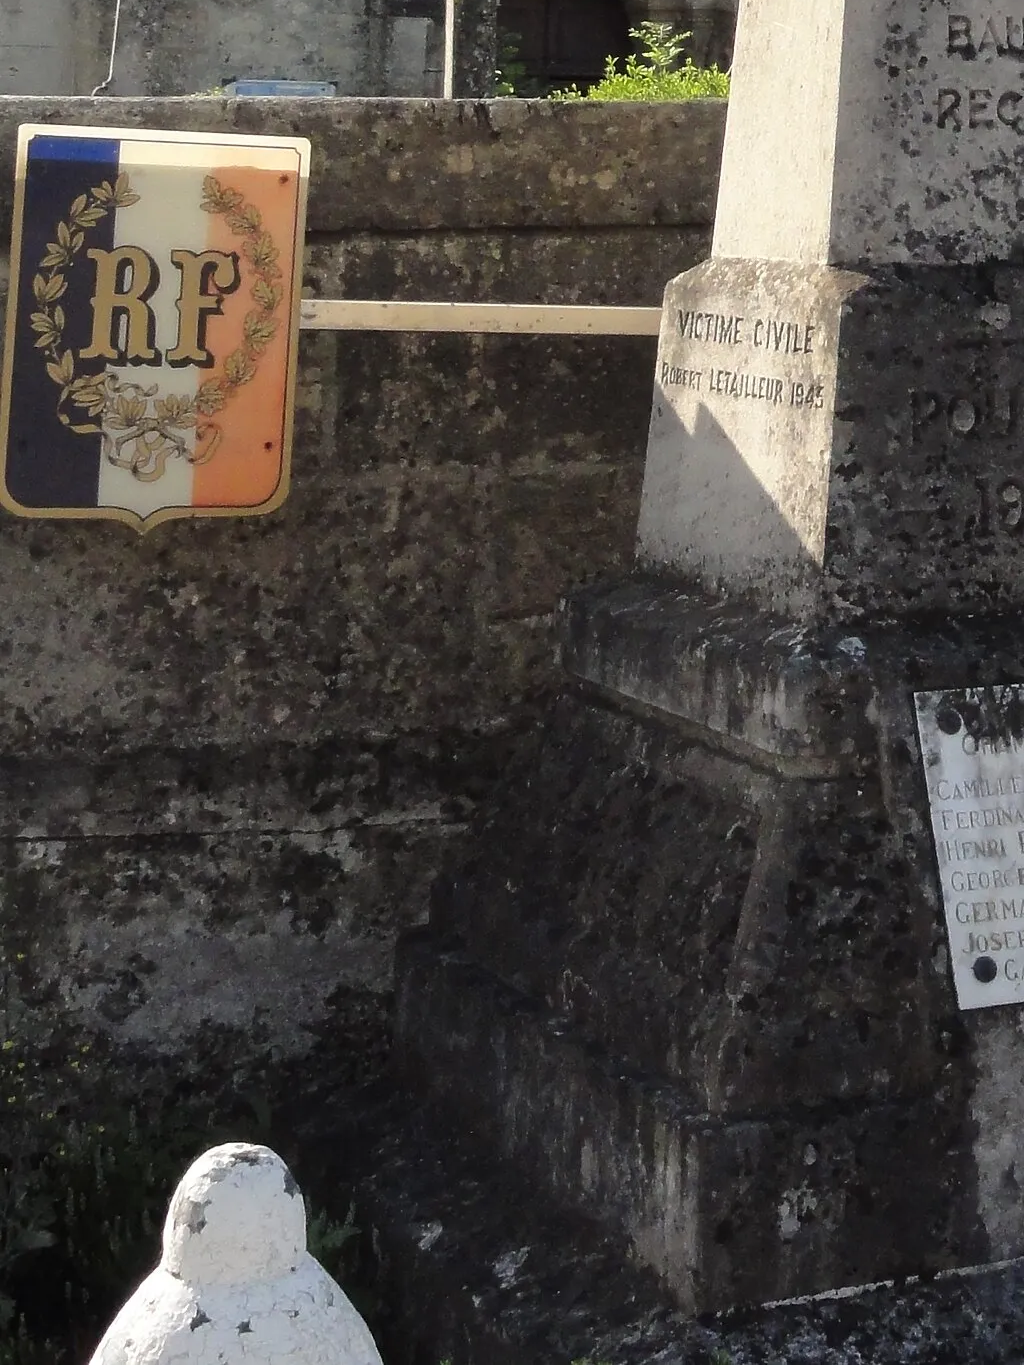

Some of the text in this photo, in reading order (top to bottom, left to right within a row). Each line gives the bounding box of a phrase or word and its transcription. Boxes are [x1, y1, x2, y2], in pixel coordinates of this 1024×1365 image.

[79, 244, 242, 369] RF
[678, 310, 816, 355] VICTIME CIVILE
[660, 361, 703, 392] ROBERT
[709, 368, 783, 406] LETAILLEUR
[936, 776, 1023, 801] CAMILLE
[942, 837, 1007, 862] HENRI
